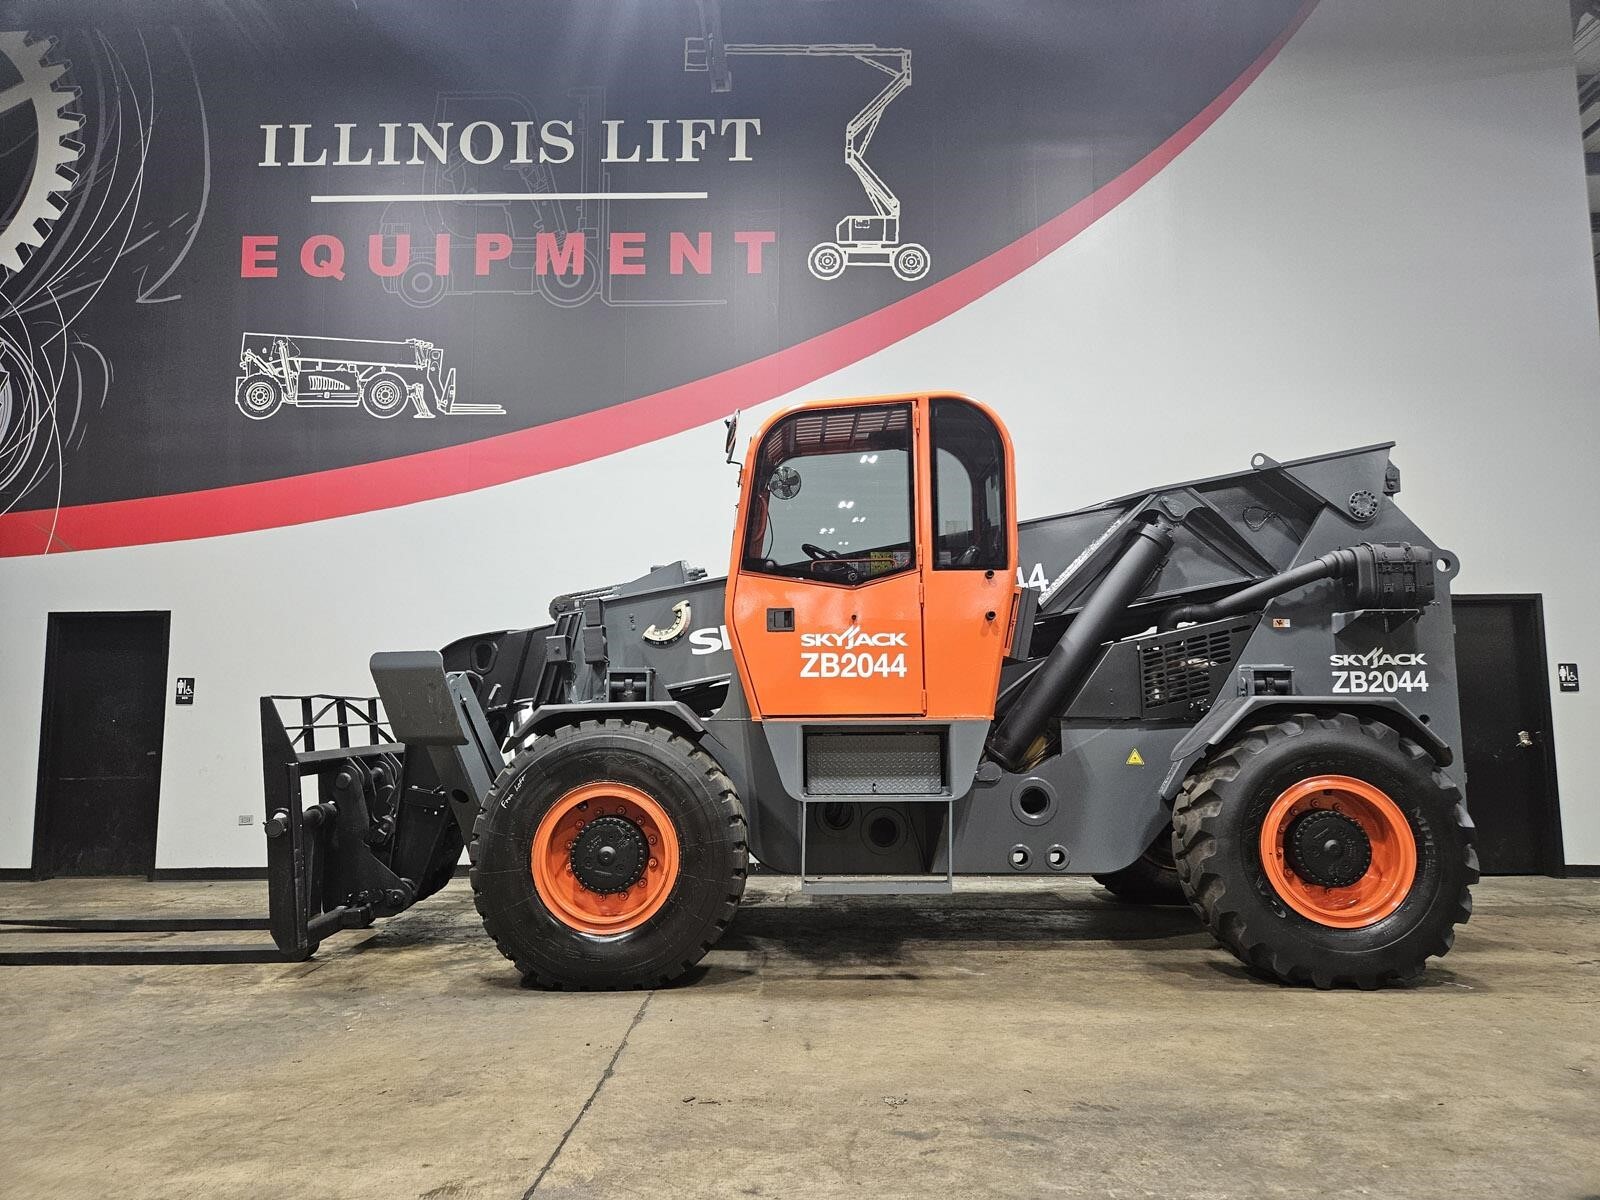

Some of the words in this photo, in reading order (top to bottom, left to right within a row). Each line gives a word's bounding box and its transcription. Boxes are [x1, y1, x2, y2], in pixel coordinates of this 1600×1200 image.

[258, 119, 575, 167] ILLINOIS
[600, 118, 762, 163] LIFT
[240, 231, 777, 281] EQUIPMENT
[800, 624, 909, 650] SKYJACK
[799, 652, 908, 678] ZB2044
[1329, 646, 1428, 669] SKYJACK
[1331, 670, 1430, 694] ZB2044
